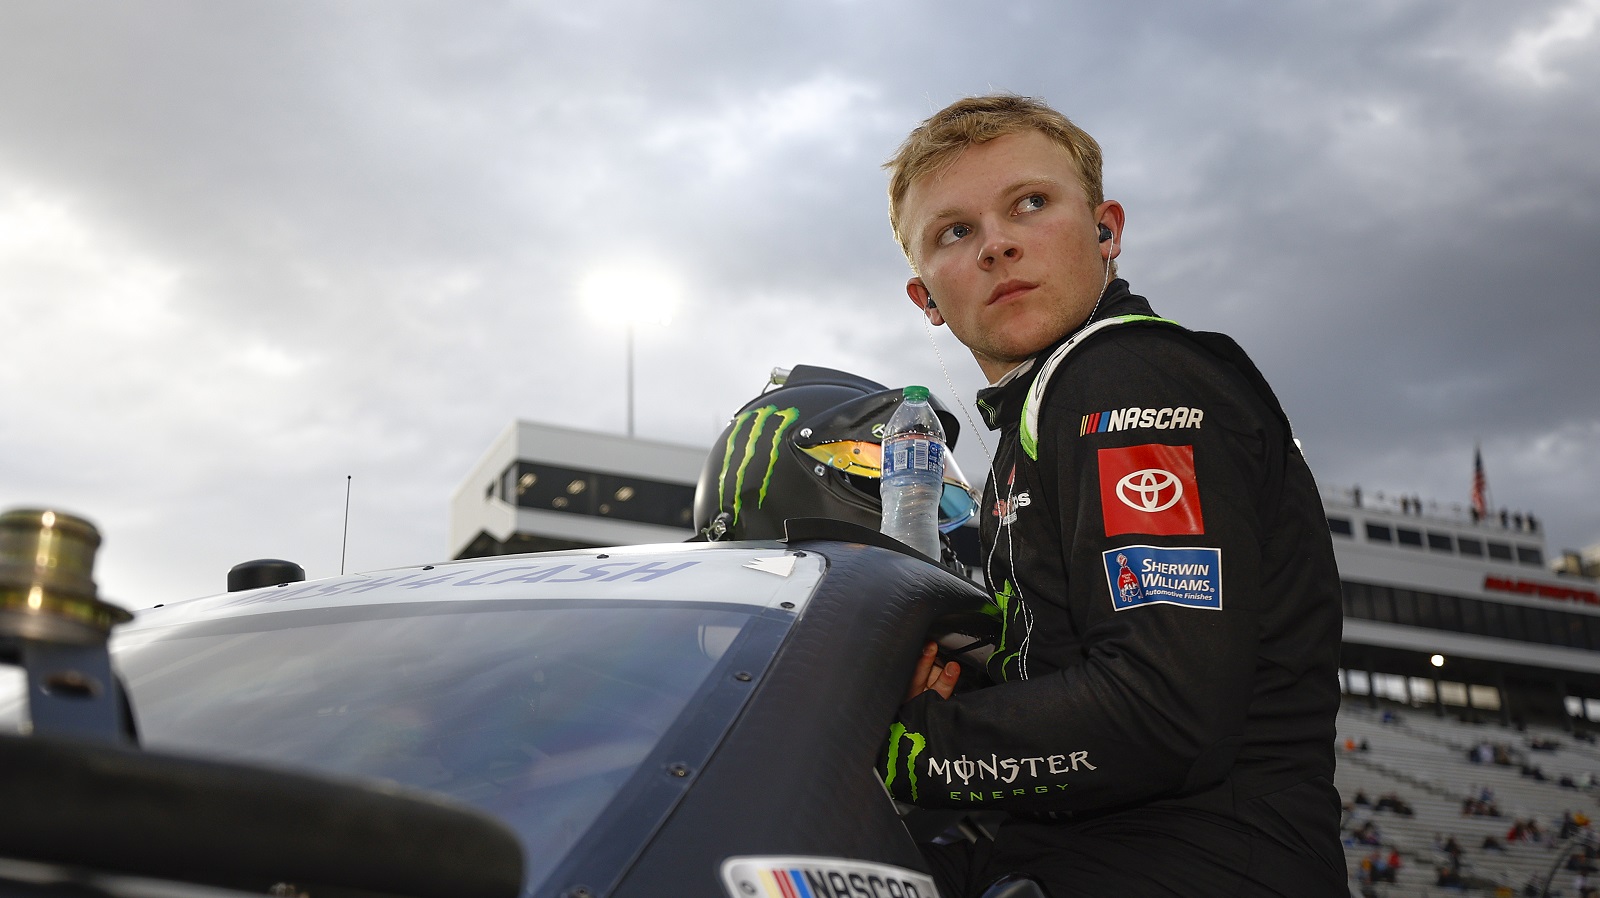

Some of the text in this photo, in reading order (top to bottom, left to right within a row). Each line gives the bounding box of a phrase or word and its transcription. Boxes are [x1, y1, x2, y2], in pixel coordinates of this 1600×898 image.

[1107, 406, 1204, 432] NASCAR
[398, 569, 474, 590] 4
[451, 561, 702, 587] CASH
[1141, 558, 1210, 576] SHERWIN
[1141, 573, 1211, 592] WILLIAMS
[1145, 589, 1213, 601] Automotive Finishes
[927, 750, 1098, 786] MONSTER
[950, 783, 1069, 802] ENERGY
